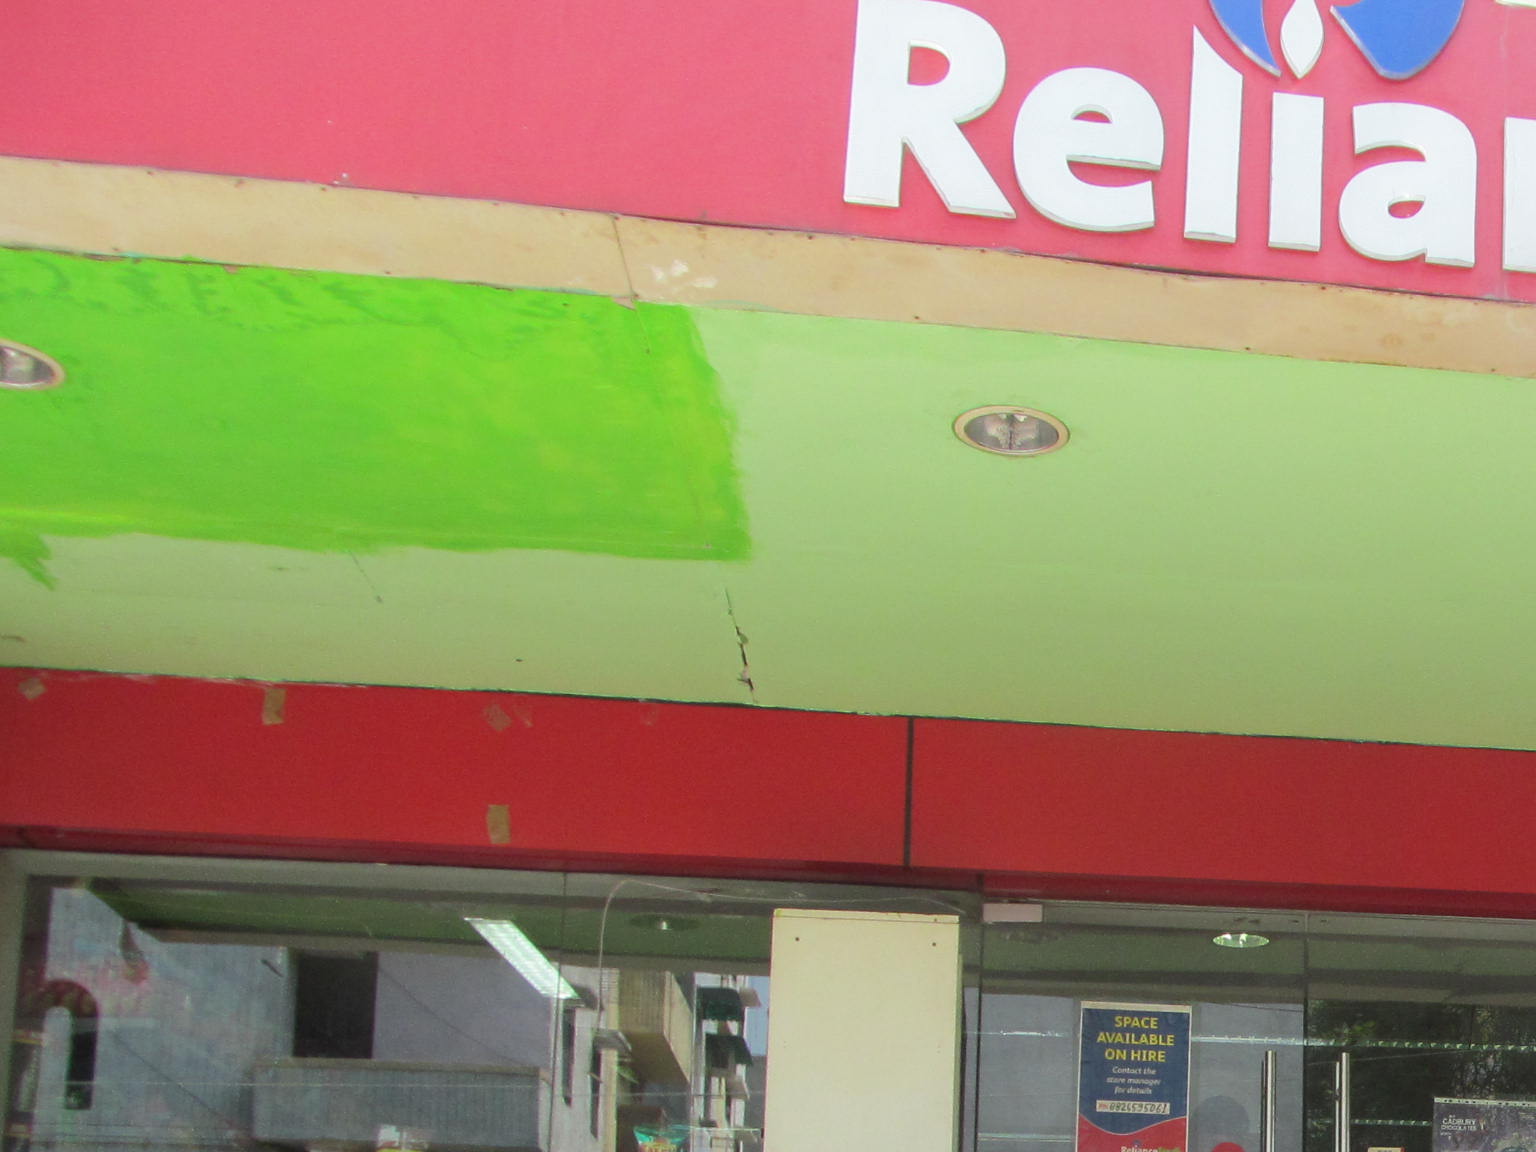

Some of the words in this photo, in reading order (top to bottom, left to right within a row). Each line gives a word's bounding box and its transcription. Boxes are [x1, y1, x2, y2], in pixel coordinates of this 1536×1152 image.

[1114, 1015, 1160, 1029] SPACE
[1096, 1031, 1175, 1047] AVAILABLE
[1104, 1048, 1127, 1061] ON
[1130, 1050, 1166, 1063] HIRE
[1112, 1066, 1142, 1075] Contact
[1143, 1067, 1157, 1075] the
